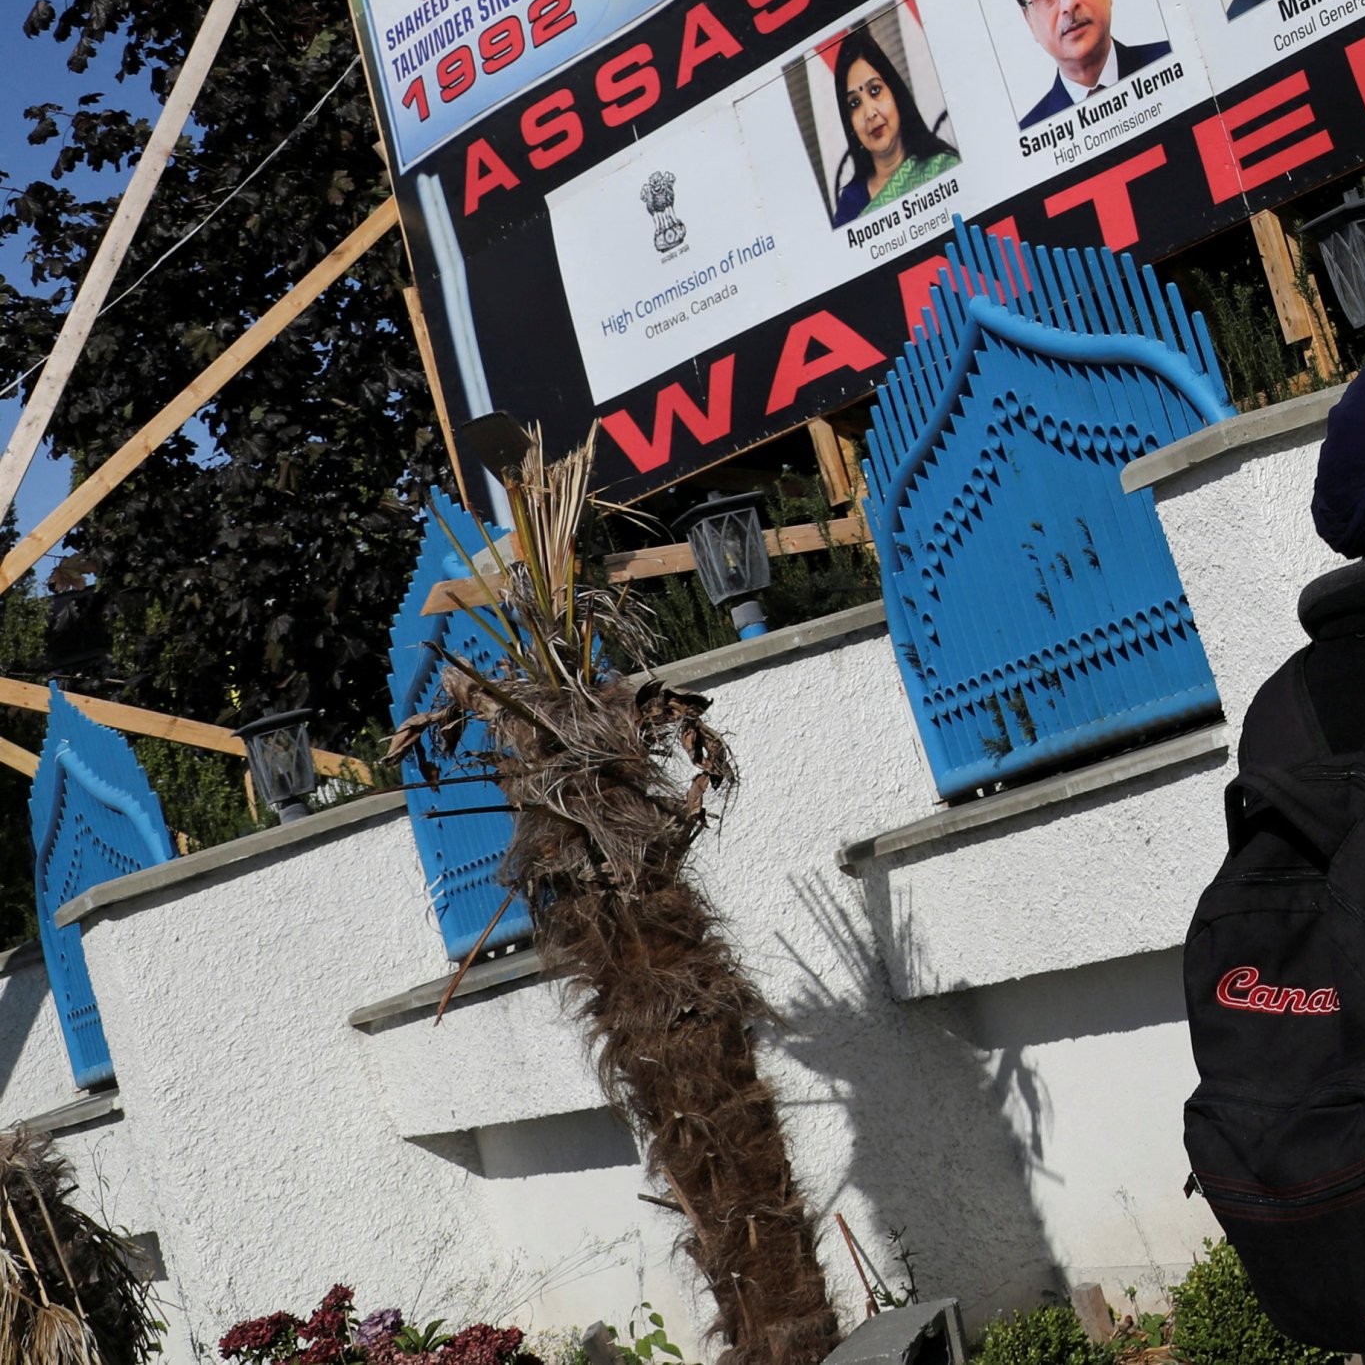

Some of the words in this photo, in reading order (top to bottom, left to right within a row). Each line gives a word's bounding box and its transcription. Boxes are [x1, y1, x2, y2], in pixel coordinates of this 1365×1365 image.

[392, 6, 475, 82] TALWINDER
[1273, 15, 1317, 52] Consul
[1019, 119, 1074, 158] Sanjay
[1077, 90, 1129, 130] Kumar
[1131, 62, 1185, 100] Verma
[1053, 143, 1082, 166] High
[1083, 102, 1164, 151] Commissioner
[846, 209, 901, 249] Apoorva
[901, 177, 960, 219] Srivastva
[869, 235, 908, 261] Consul
[910, 207, 951, 241] General
[601, 307, 633, 338] High
[634, 265, 718, 321] Commission
[718, 253, 736, 274] of
[735, 234, 776, 267] India
[644, 314, 690, 340] Ottawa,
[690, 283, 738, 317] Canada
[1217, 966, 1340, 1013] Cana
